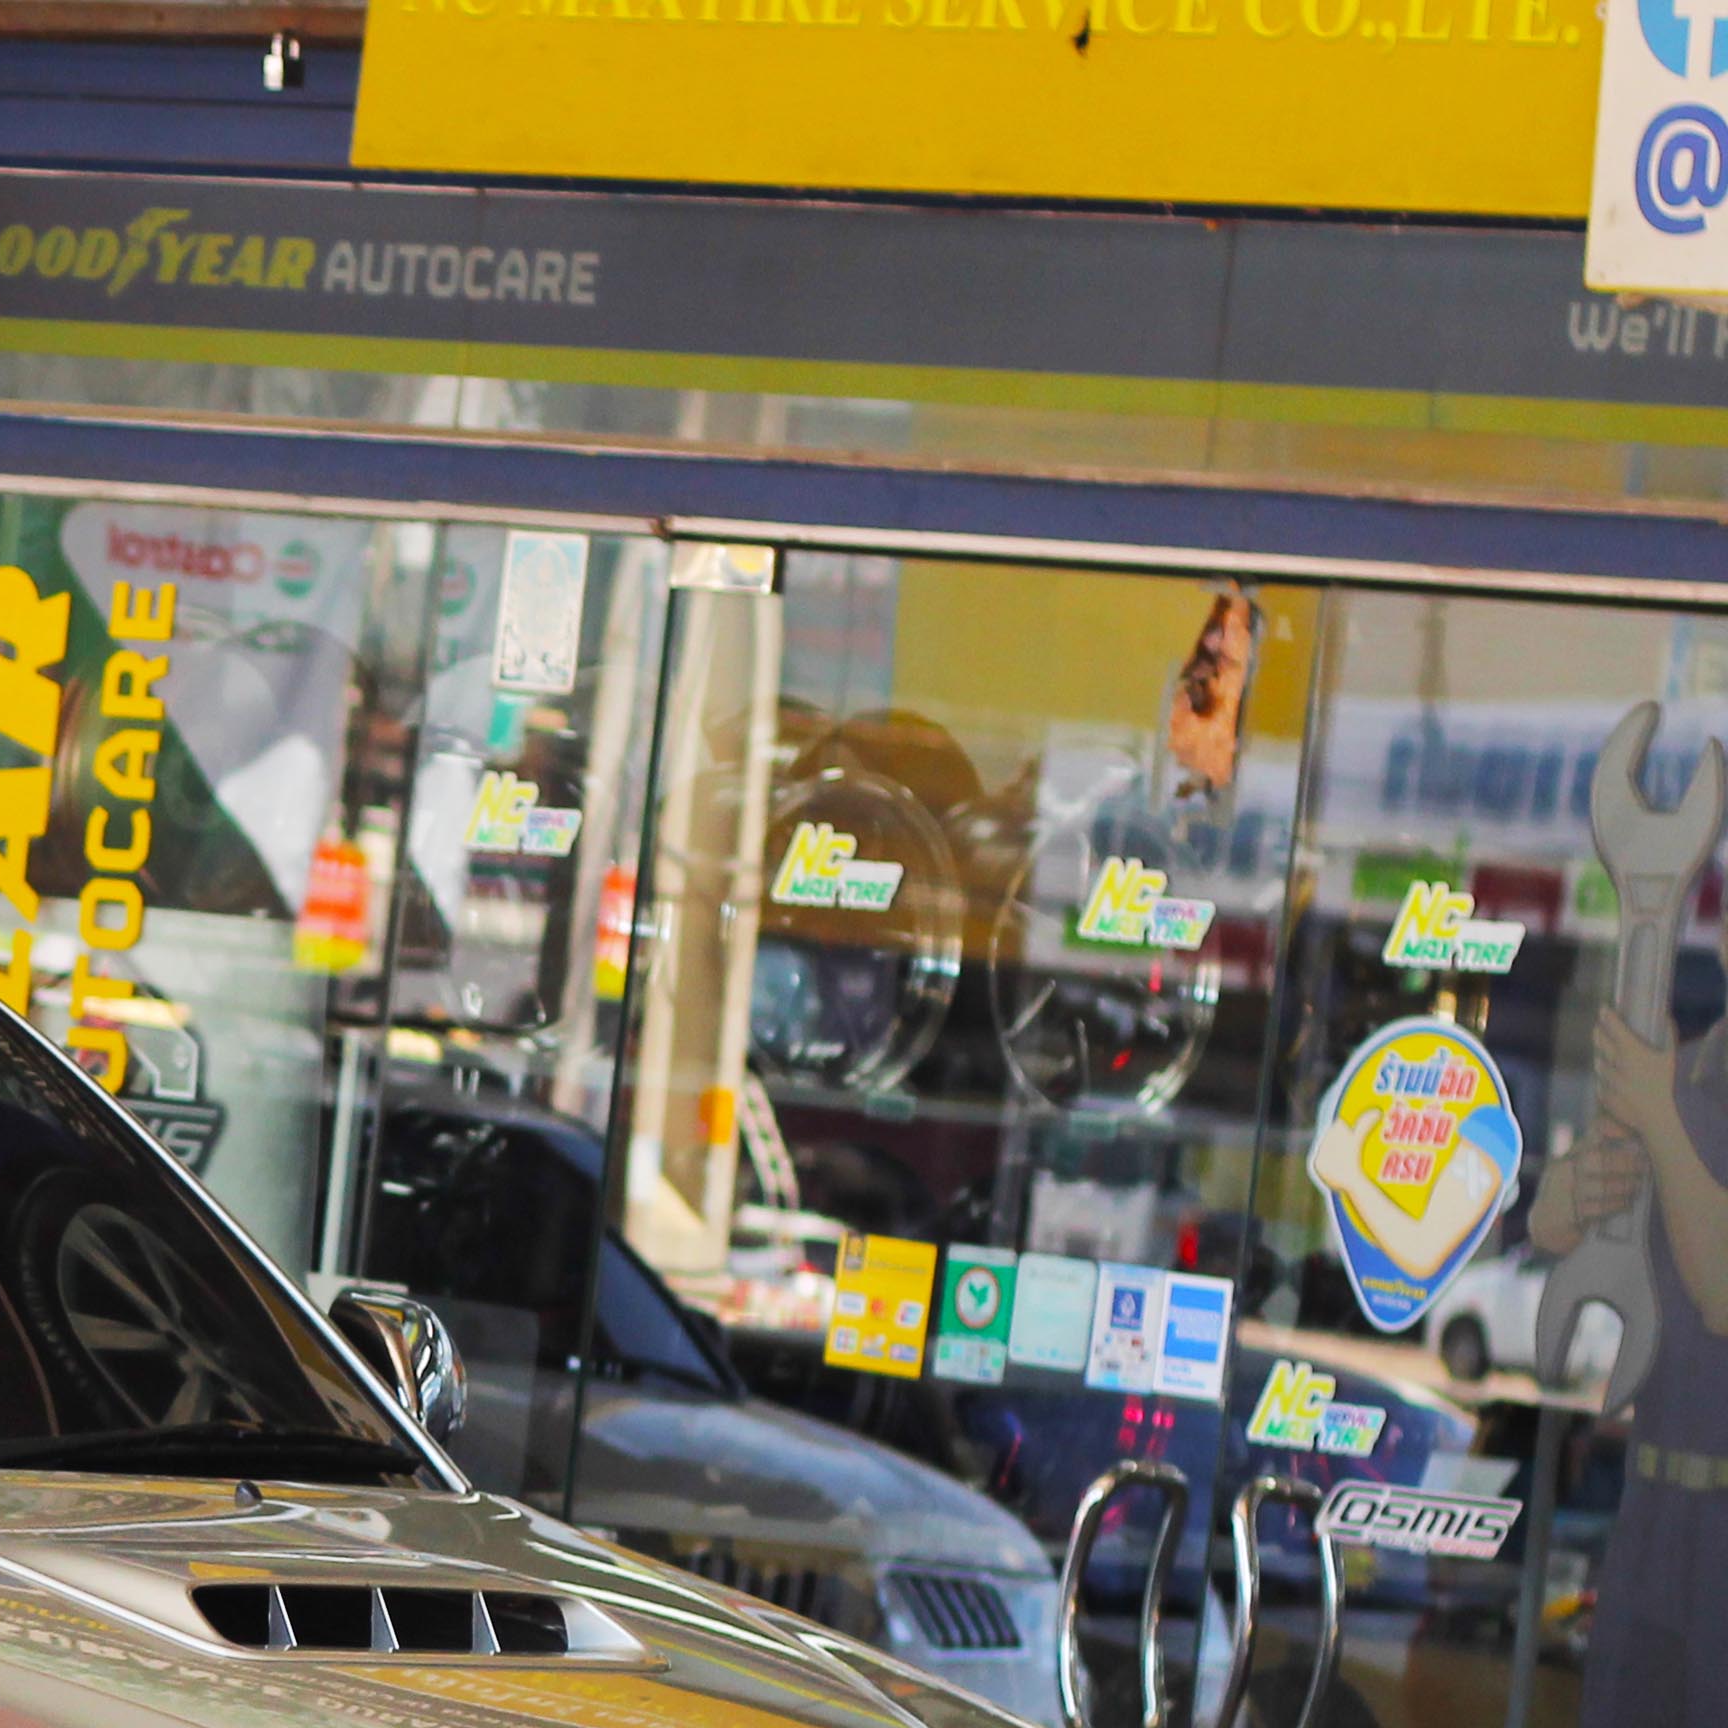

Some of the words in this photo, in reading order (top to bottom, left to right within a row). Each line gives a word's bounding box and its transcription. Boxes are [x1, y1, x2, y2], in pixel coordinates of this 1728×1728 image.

[322, 239, 600, 305] AUTOCARE
[1568, 301, 1696, 358] We'll
[465, 776, 535, 843] NC
[778, 827, 852, 897] NC
[845, 879, 893, 903] TIRE
[1083, 862, 1164, 930] NC
[1389, 887, 1470, 957] NC
[1461, 940, 1515, 965] TIRE
[1253, 1366, 1334, 1435] NC
[1327, 1484, 1518, 1543] COSMIS
